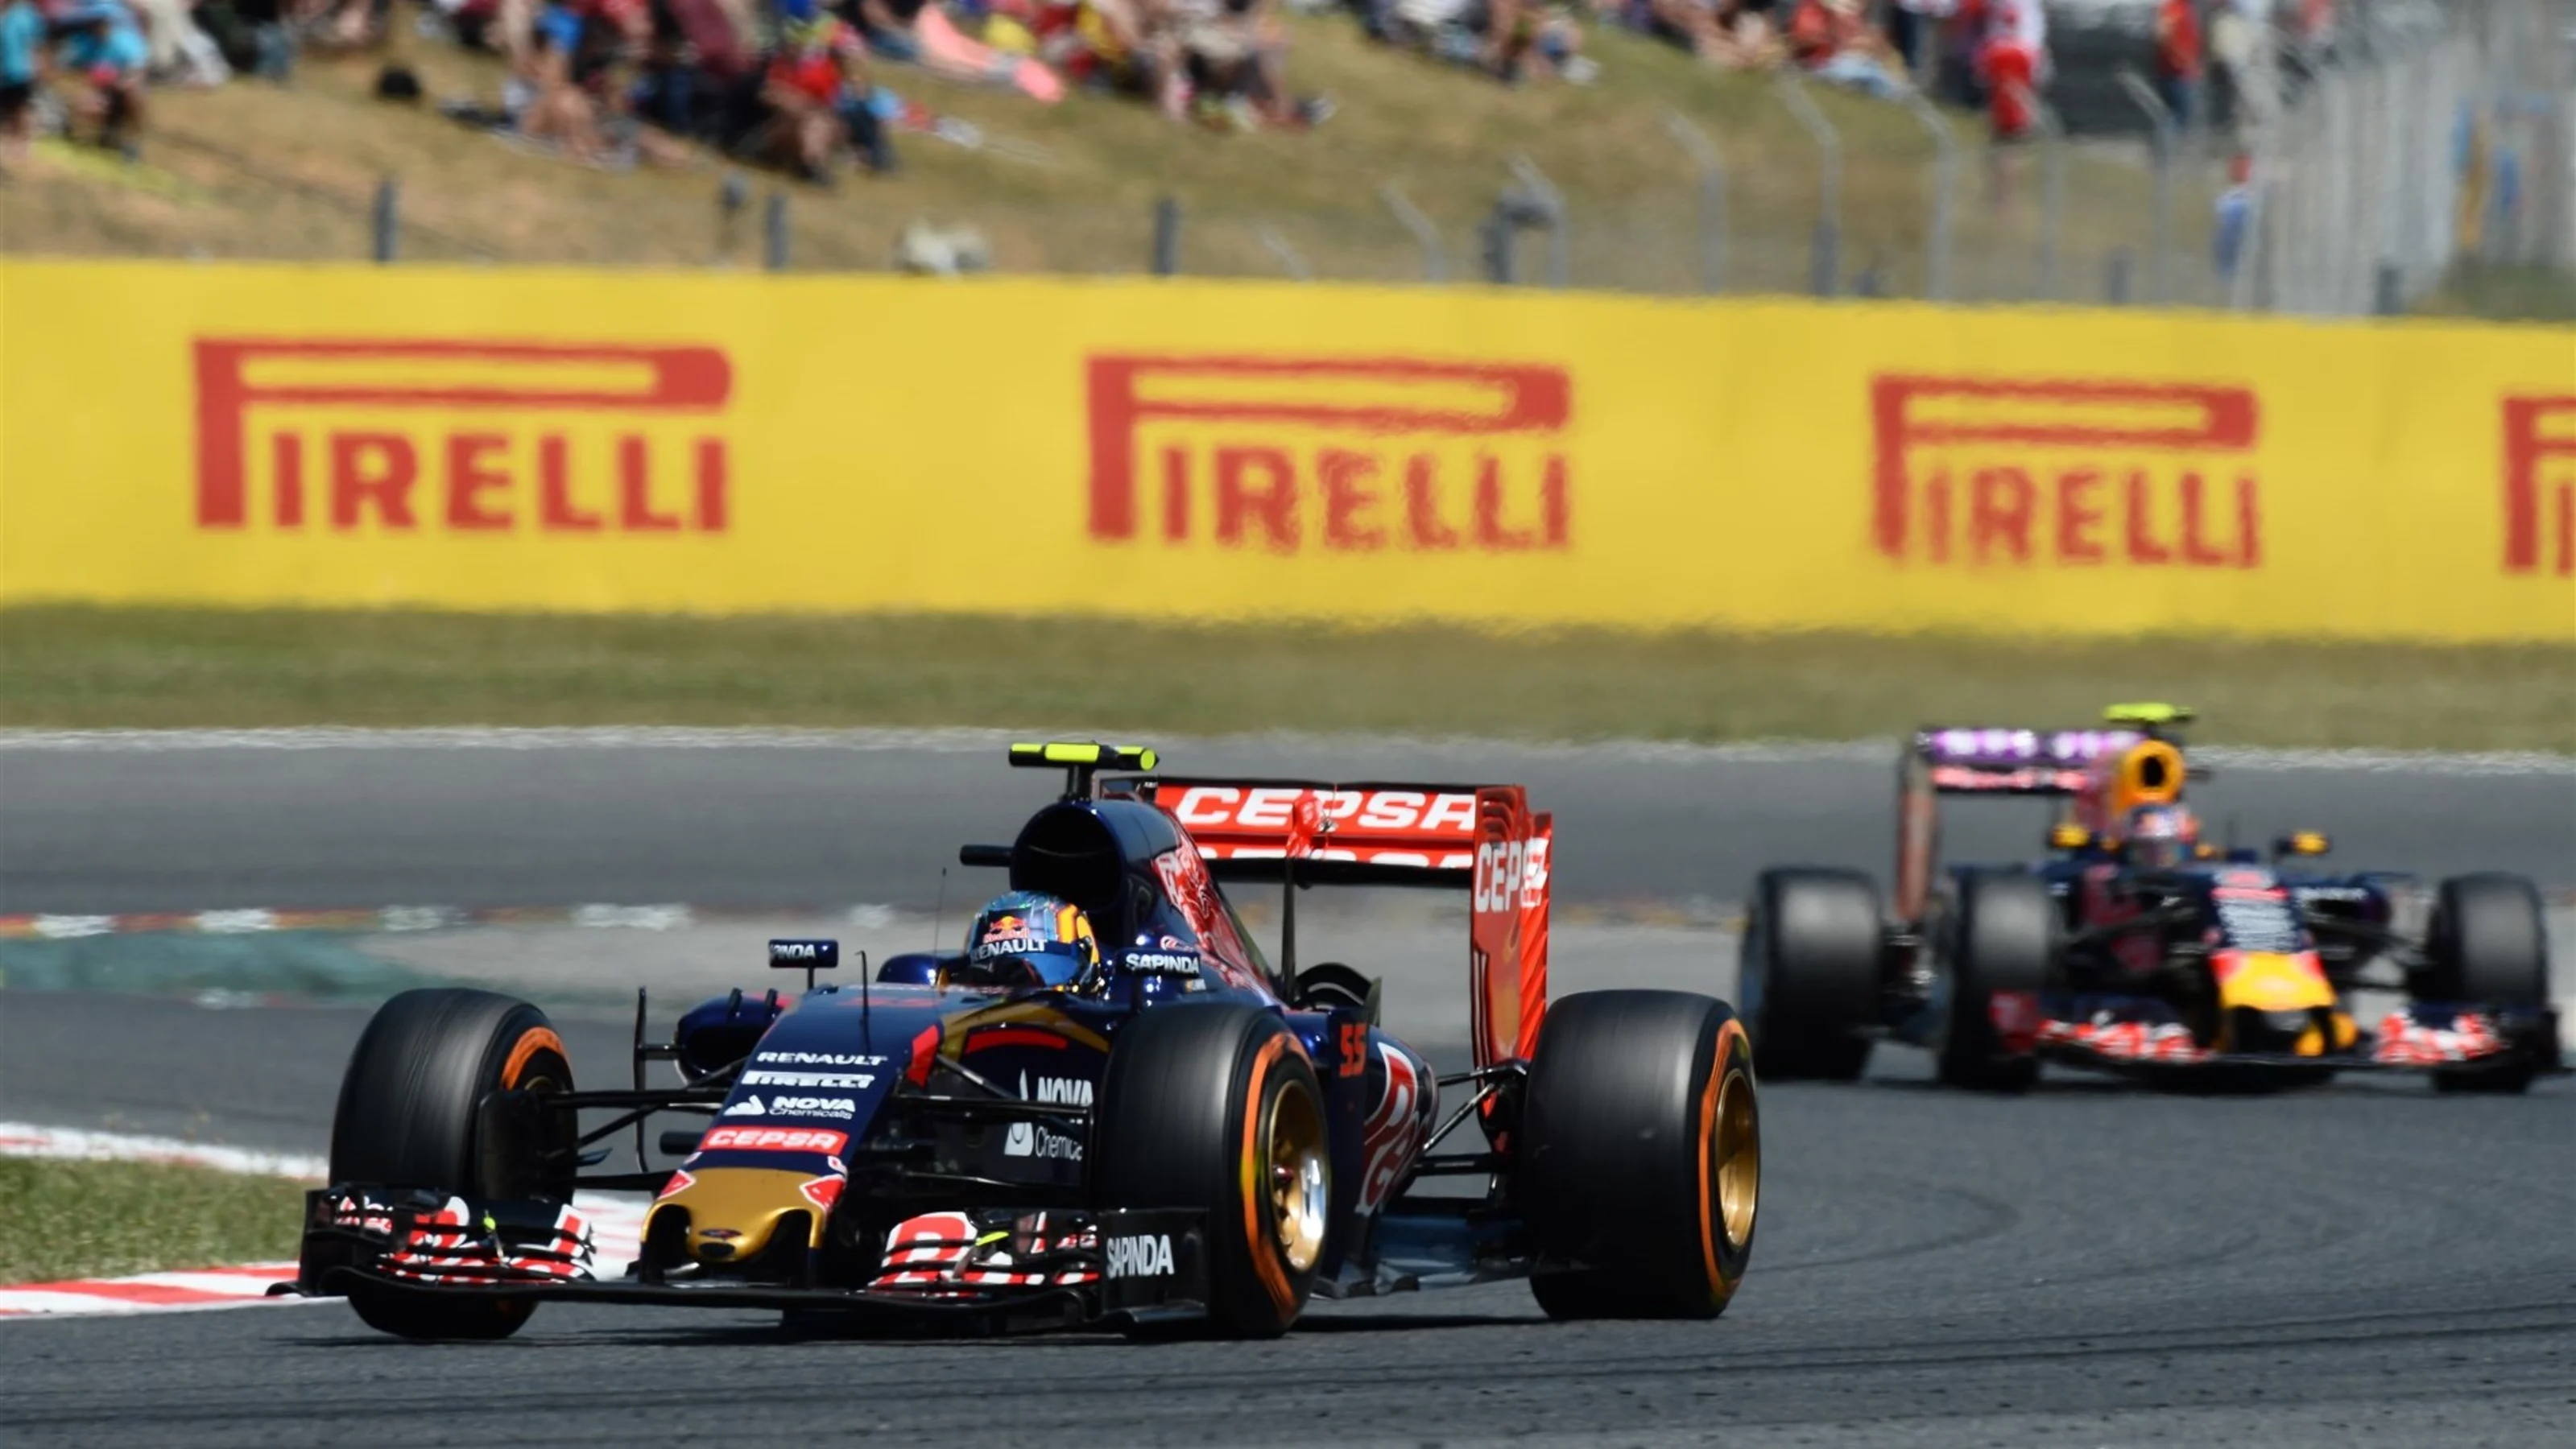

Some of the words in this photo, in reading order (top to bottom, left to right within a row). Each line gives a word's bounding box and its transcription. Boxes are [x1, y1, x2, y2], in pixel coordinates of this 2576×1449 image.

[192, 336, 733, 533] PIRELLI
[1085, 354, 1573, 552] PIRELLI
[1869, 374, 2260, 570] PIRELLI
[1175, 786, 1475, 832] CEPSA
[1125, 952, 1200, 974] SAPINDA
[756, 1051, 888, 1066] RENAULT
[1339, 1023, 1367, 1077] 55
[740, 1070, 875, 1089] PIRELLI
[1036, 1076, 1094, 1107] NOVA
[769, 1108, 854, 1121] Chemicals
[772, 1096, 856, 1113] NOVA
[707, 1129, 840, 1150] CEPSA
[1106, 1234, 1175, 1279] SAPINDA
